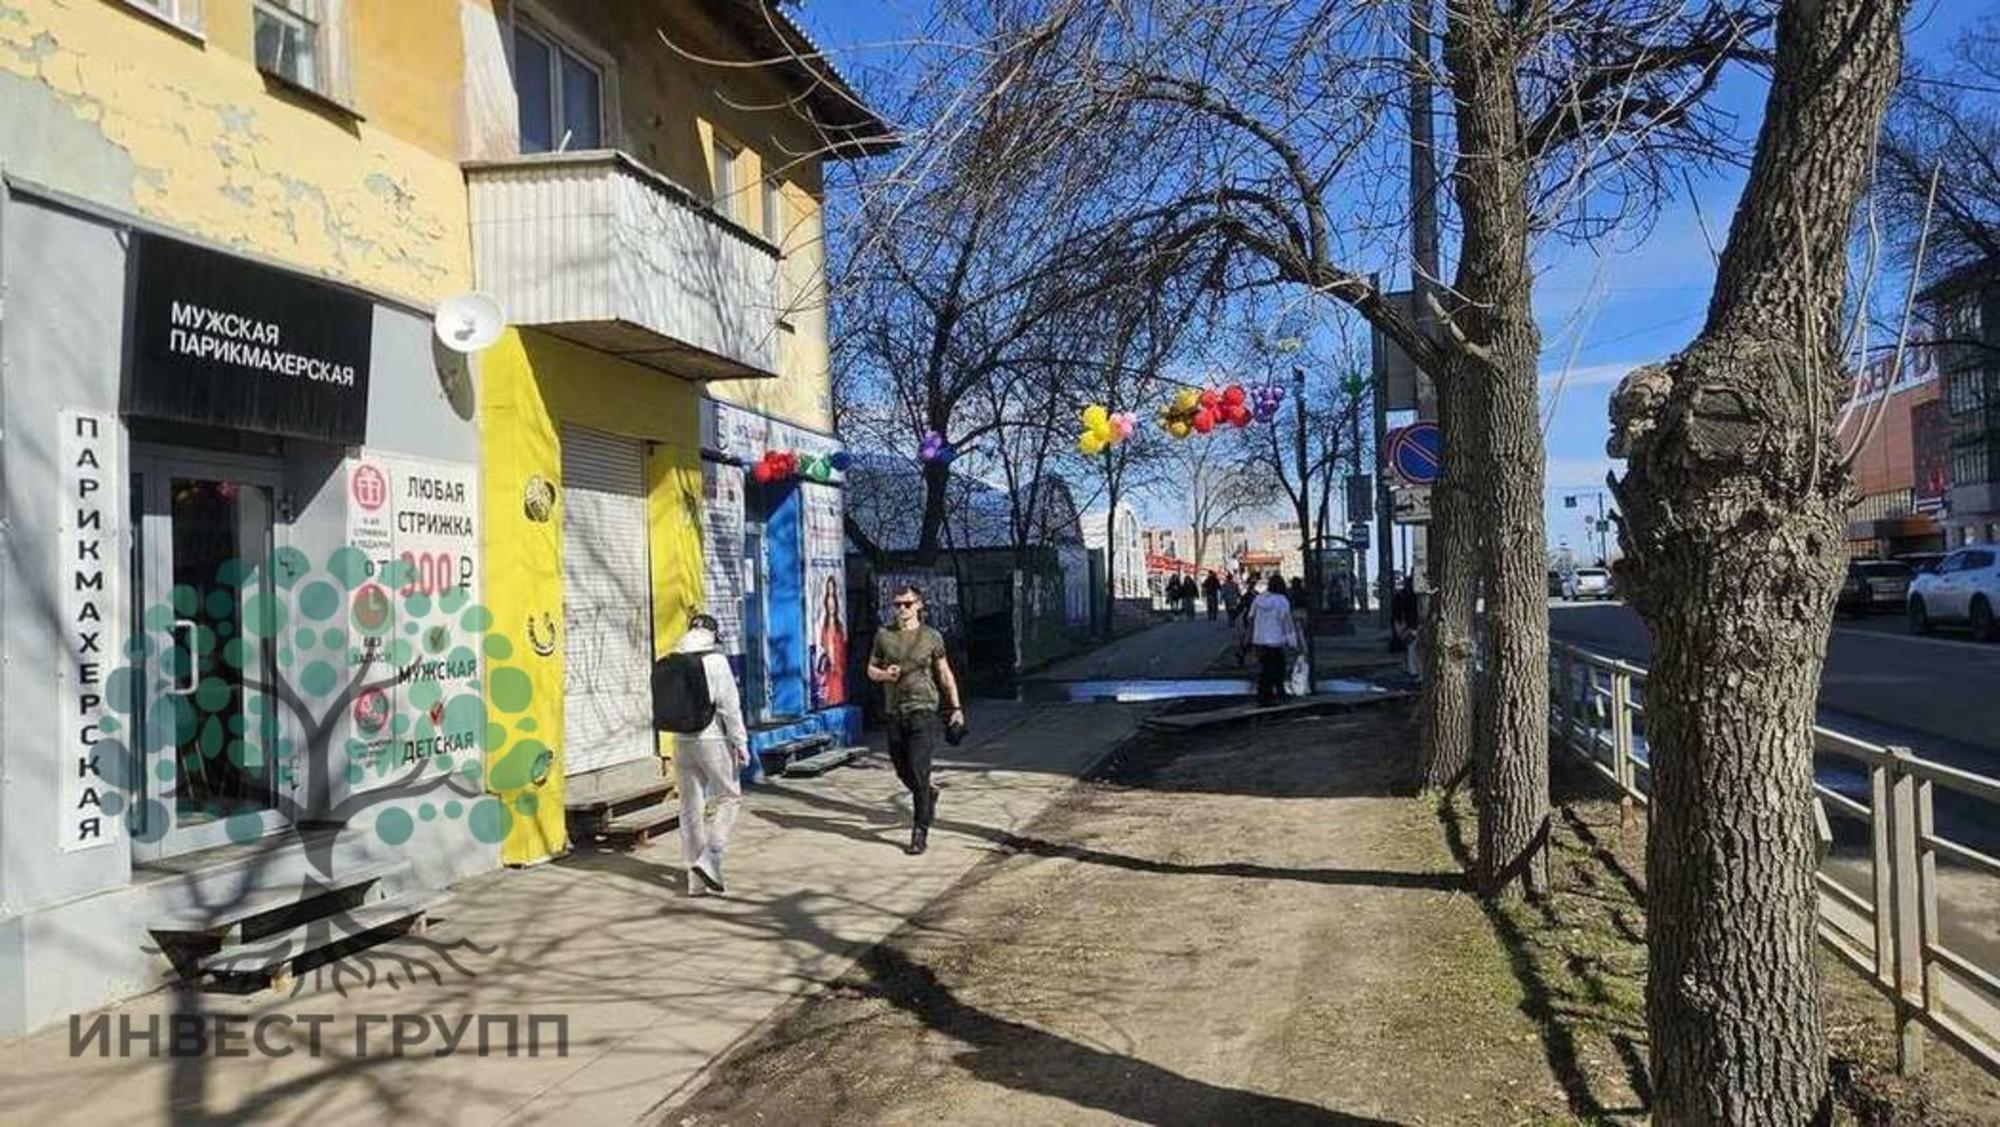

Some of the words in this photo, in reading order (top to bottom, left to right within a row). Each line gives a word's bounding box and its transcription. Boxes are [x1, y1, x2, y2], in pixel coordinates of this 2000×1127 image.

[171, 301, 279, 346] МУЖСКАЯ
[170, 329, 354, 386] ПАРИКМАХЕРСКАЯ
[408, 476, 465, 502] ЛЮБАЯ
[398, 511, 473, 536] СТРИЖКА
[400, 551, 452, 598] 300
[75, 417, 103, 840] ПАРИКМАХЕРСКАЯ
[398, 660, 477, 683] МУЖСКАЯ
[402, 732, 474, 765] ДЕТСКАЯ
